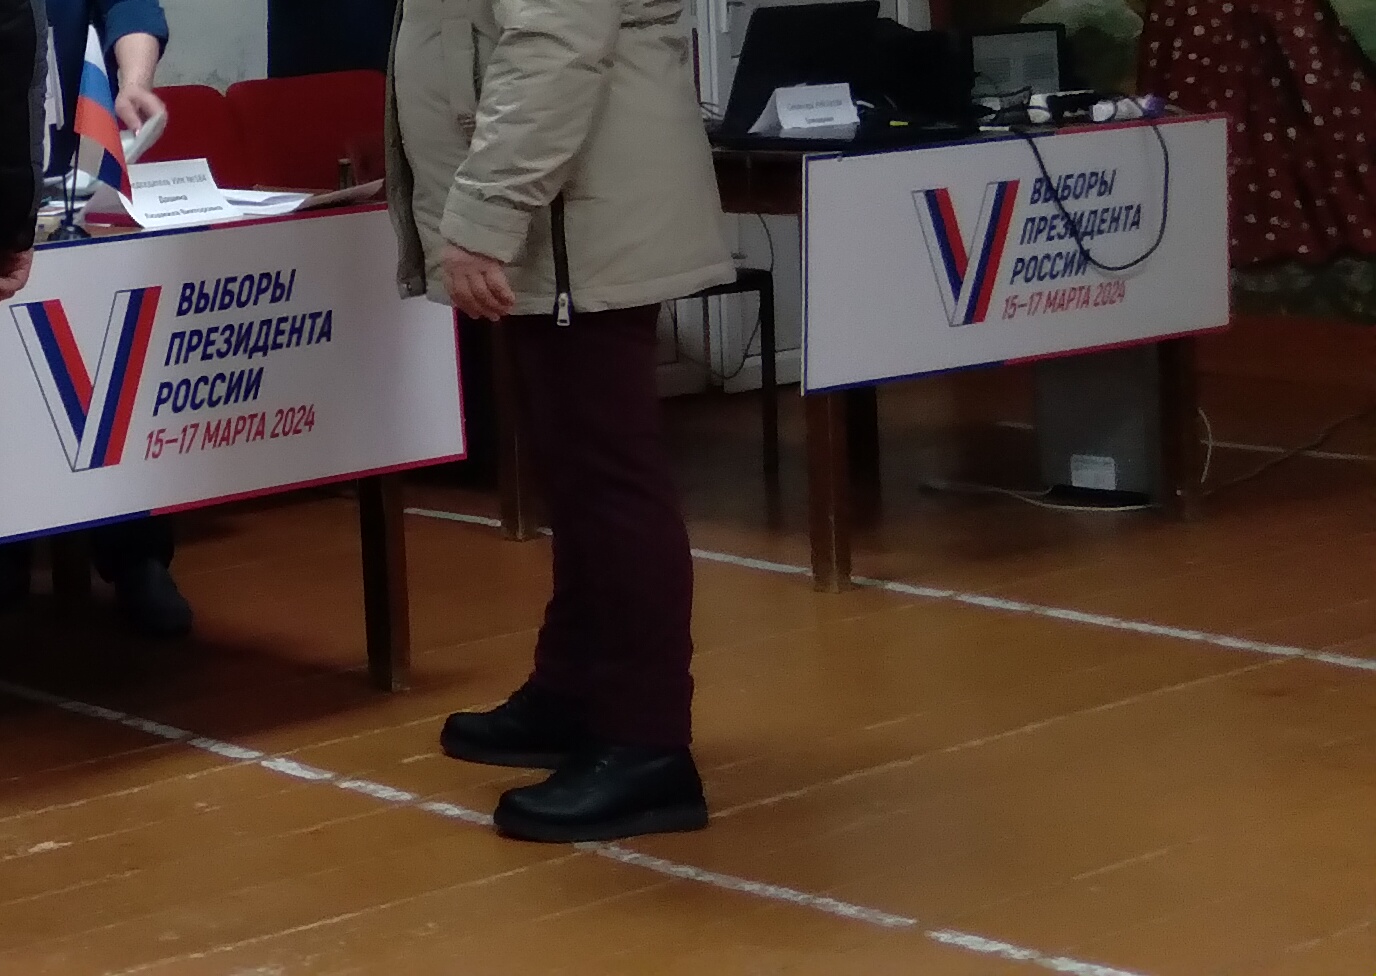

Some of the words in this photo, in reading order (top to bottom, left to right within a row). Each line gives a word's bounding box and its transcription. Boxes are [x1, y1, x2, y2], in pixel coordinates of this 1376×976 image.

[1030, 168, 1117, 205] ВЫБОРЫ
[1020, 203, 1142, 245] ПРЕЗИДЕНТА
[1010, 249, 1090, 285] РОССИИ
[176, 269, 297, 317] ВЫБОРЫ
[1043, 285, 1091, 314] МАРТА
[1093, 280, 1126, 307] 2024
[164, 310, 333, 366] ПРЕЗИДЕНТА
[153, 367, 264, 417] РОССИИ
[200, 412, 267, 452] МАРТА
[270, 403, 316, 439] 2024
